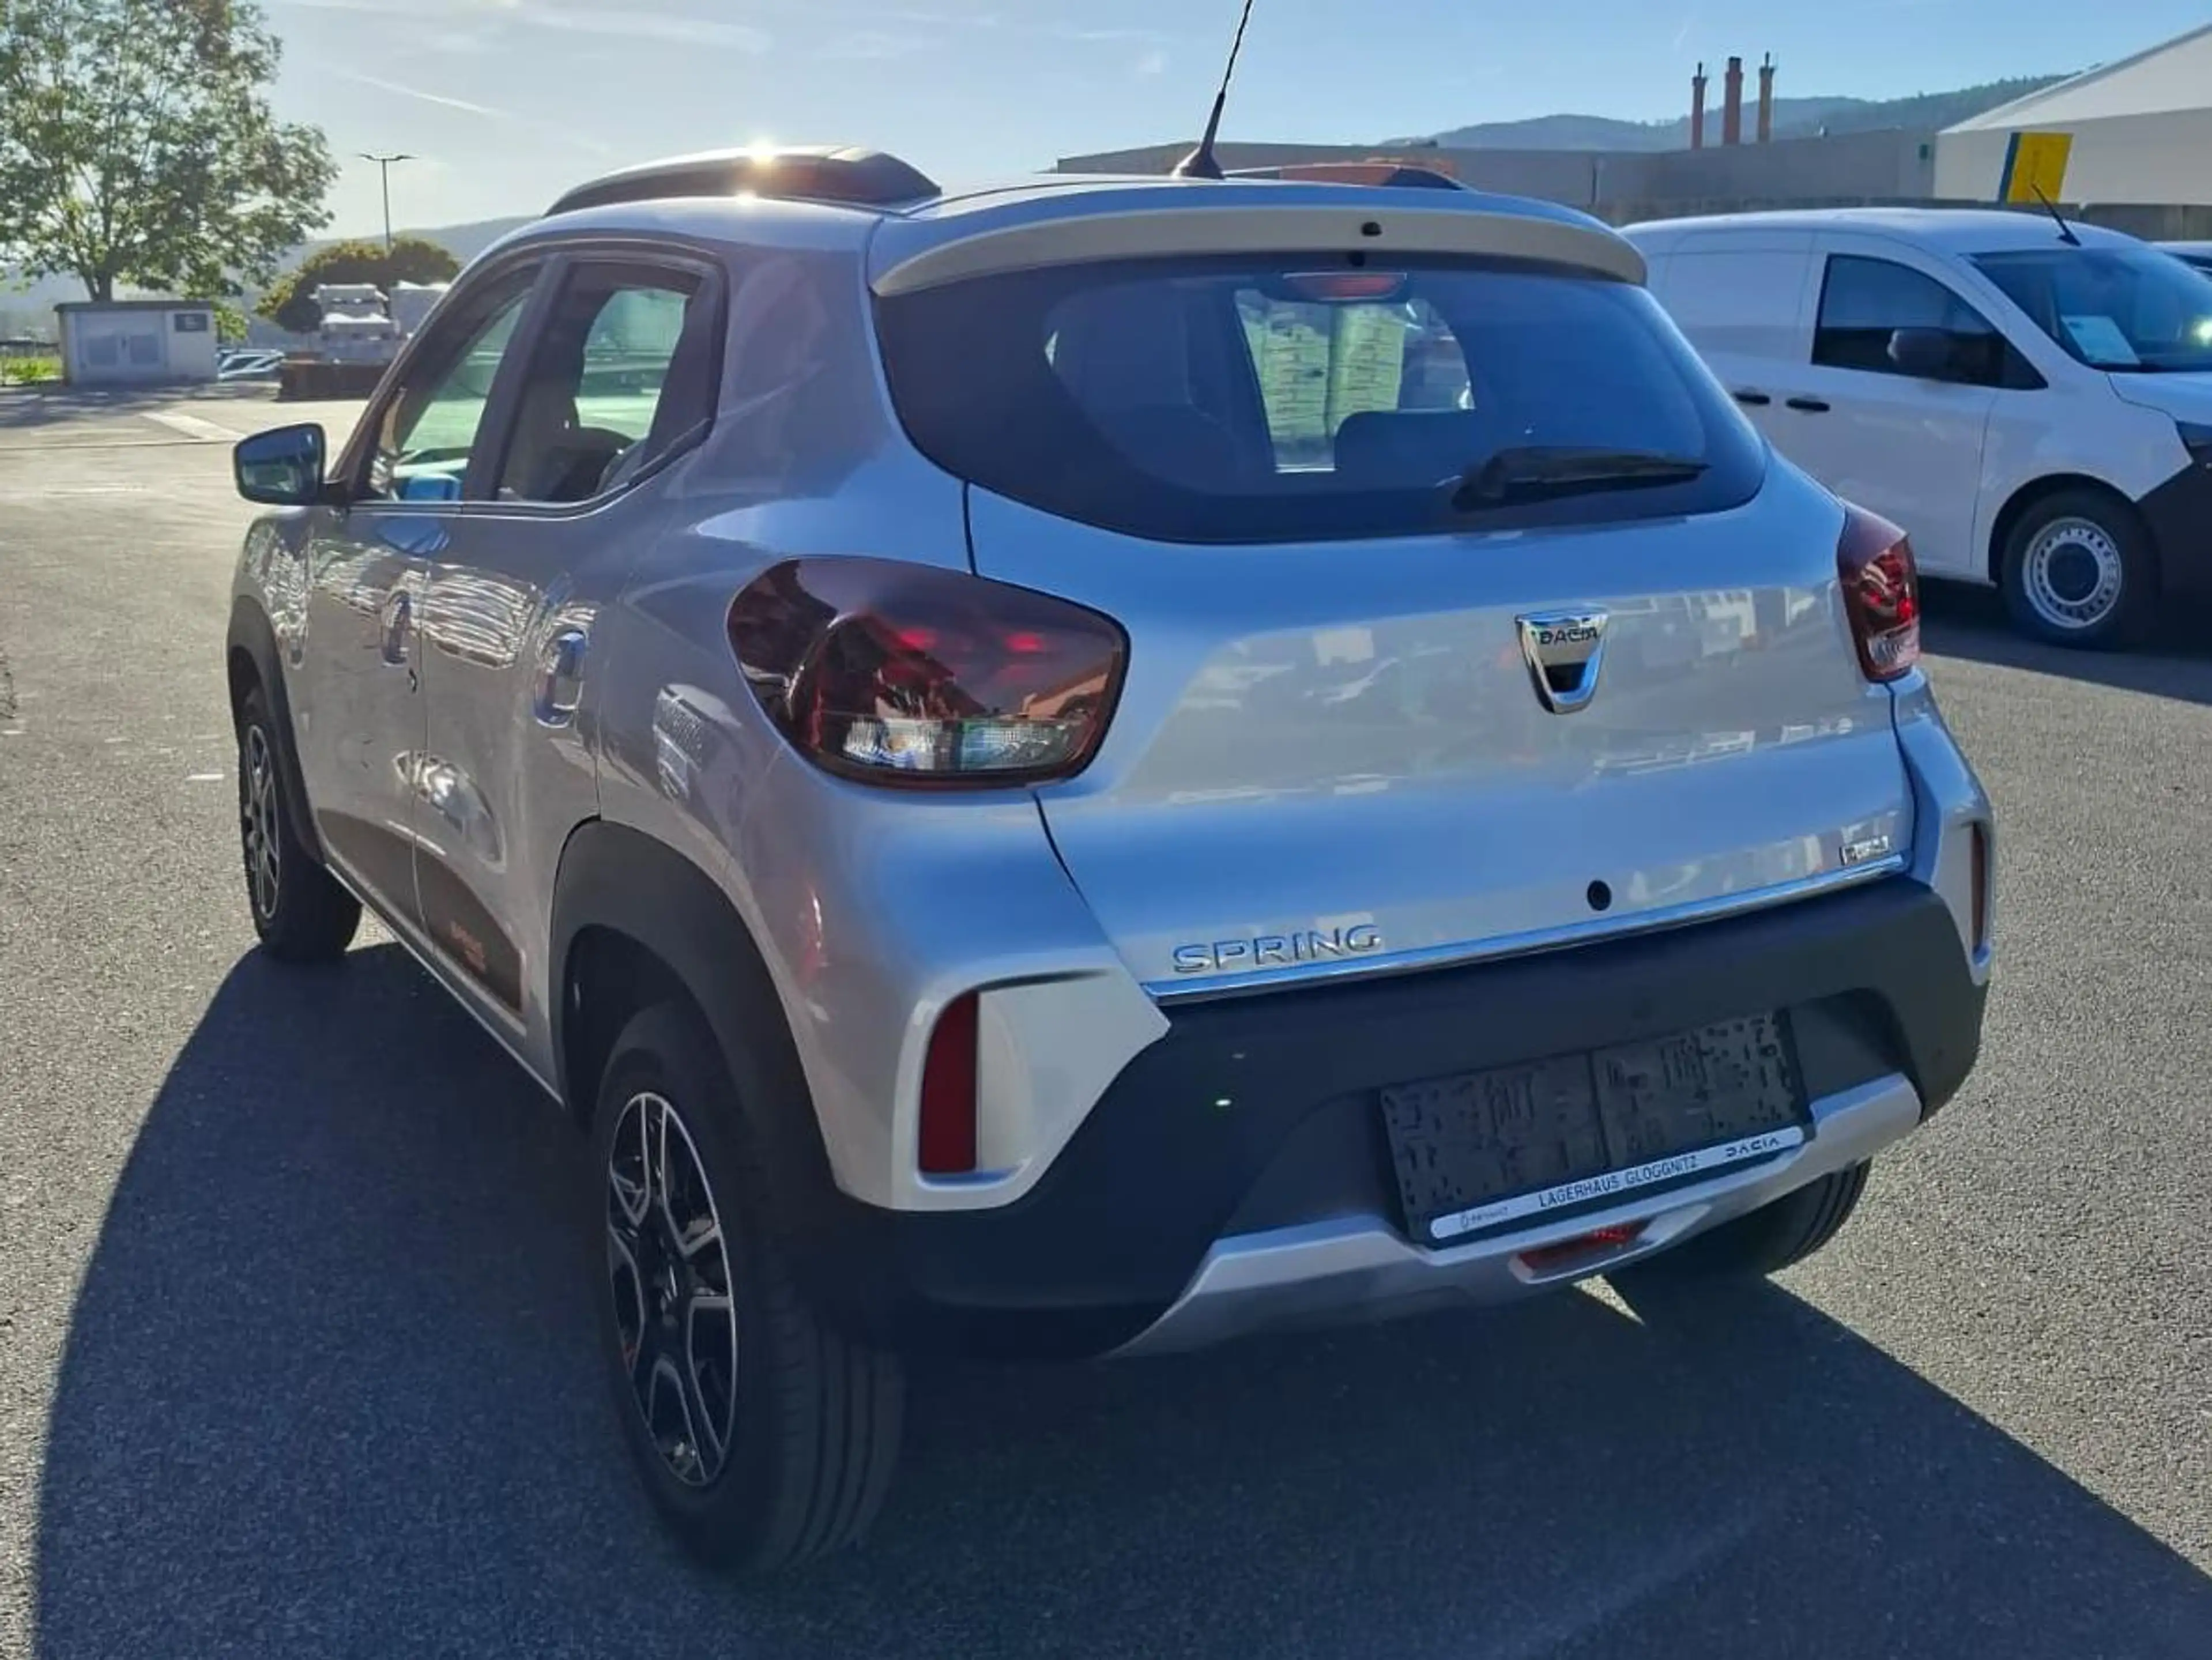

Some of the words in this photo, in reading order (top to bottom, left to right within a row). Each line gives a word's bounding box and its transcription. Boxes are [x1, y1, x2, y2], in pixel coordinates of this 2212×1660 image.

[1539, 627, 1597, 646] DACIA
[1174, 924, 1381, 972] SPRING
[1538, 1175, 1619, 1208] LAGERHAUS
[1625, 1155, 1697, 1185] GLOGGNITZ
[1725, 1137, 1779, 1157] DACIA
